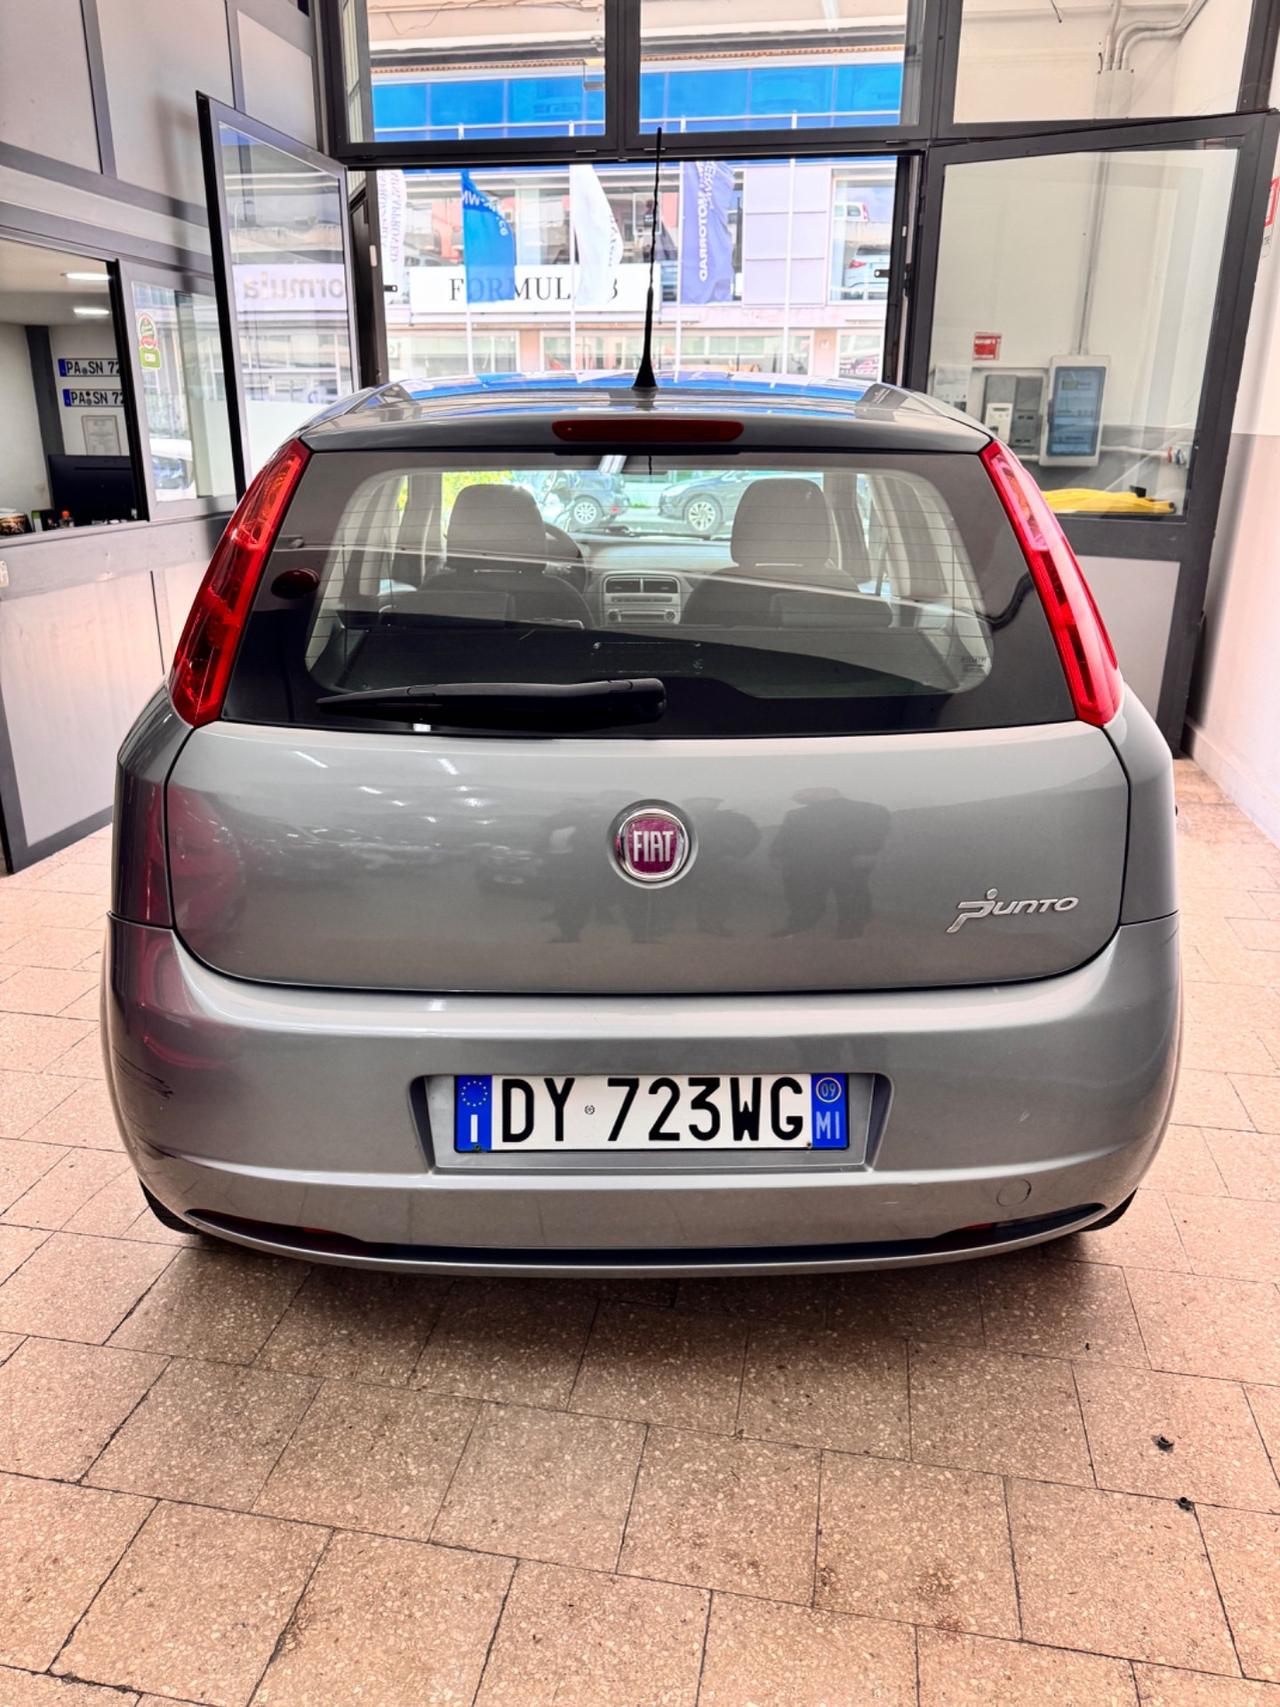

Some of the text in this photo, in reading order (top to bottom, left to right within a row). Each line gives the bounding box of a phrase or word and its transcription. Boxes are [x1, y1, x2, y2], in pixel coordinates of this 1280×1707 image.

[449, 277, 573, 301] FORMUL
[66, 361, 81, 374] PA
[88, 361, 103, 374] SN
[71, 391, 86, 405] PA
[93, 391, 108, 405] SN
[633, 830, 673, 863] FIAT
[820, 1082, 837, 1098] 09
[501, 1076, 576, 1143] DY
[607, 1076, 804, 1142] 723WG
[815, 1111, 840, 1140] MI
